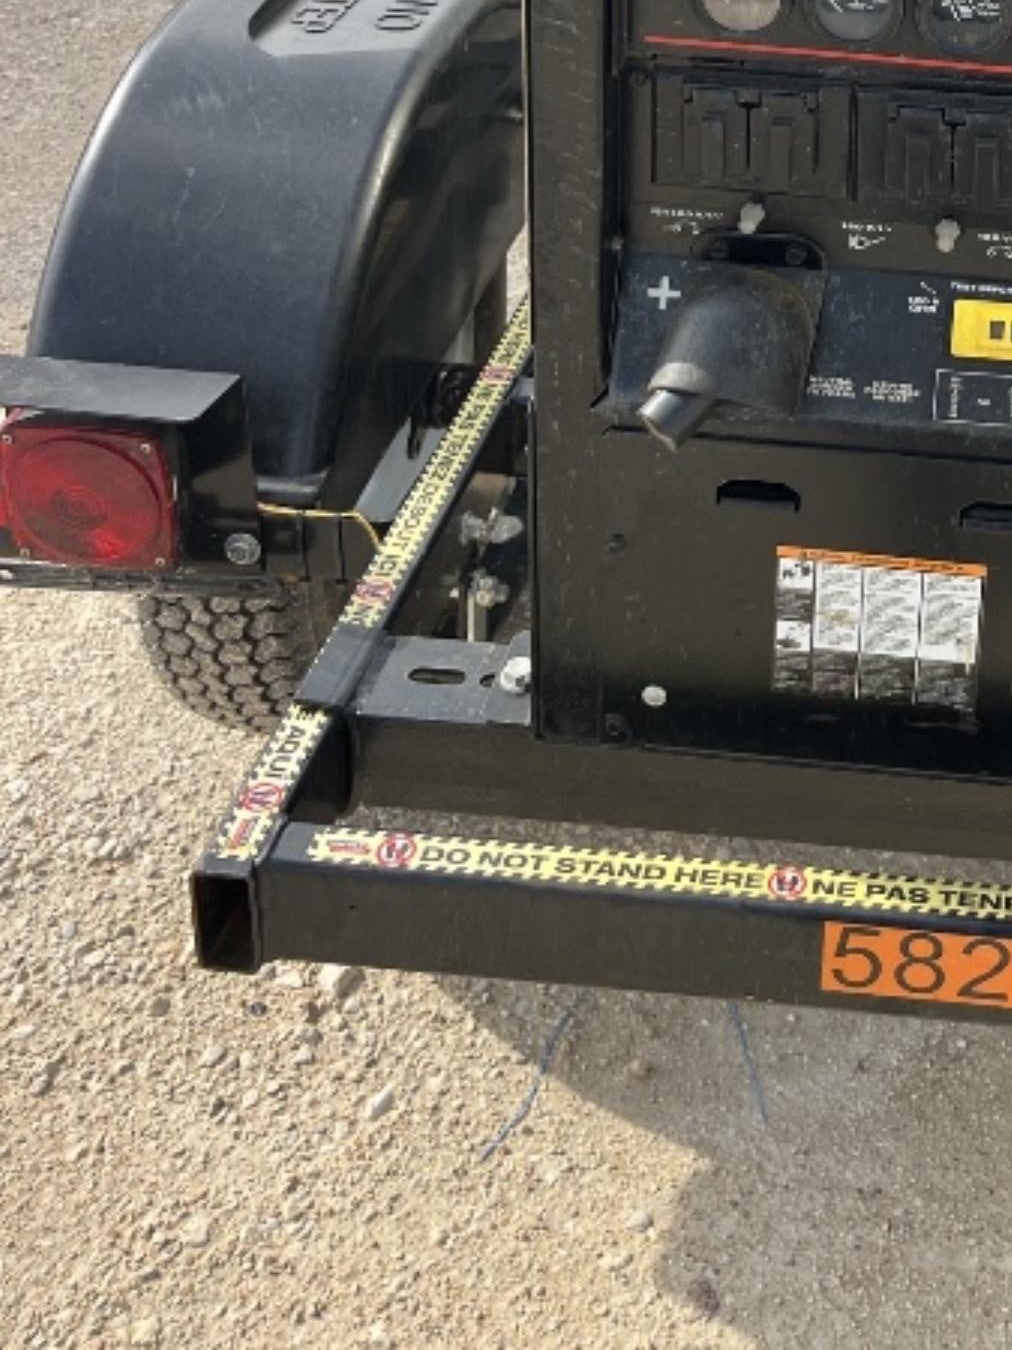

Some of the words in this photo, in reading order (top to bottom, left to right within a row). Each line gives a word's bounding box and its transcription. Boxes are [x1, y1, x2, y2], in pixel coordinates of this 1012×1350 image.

[420, 845, 471, 864] DO
[477, 849, 549, 870] NOT
[554, 854, 669, 883] STAND
[673, 865, 767, 890] HERE
[811, 877, 858, 899] NE
[865, 882, 931, 905] PAS
